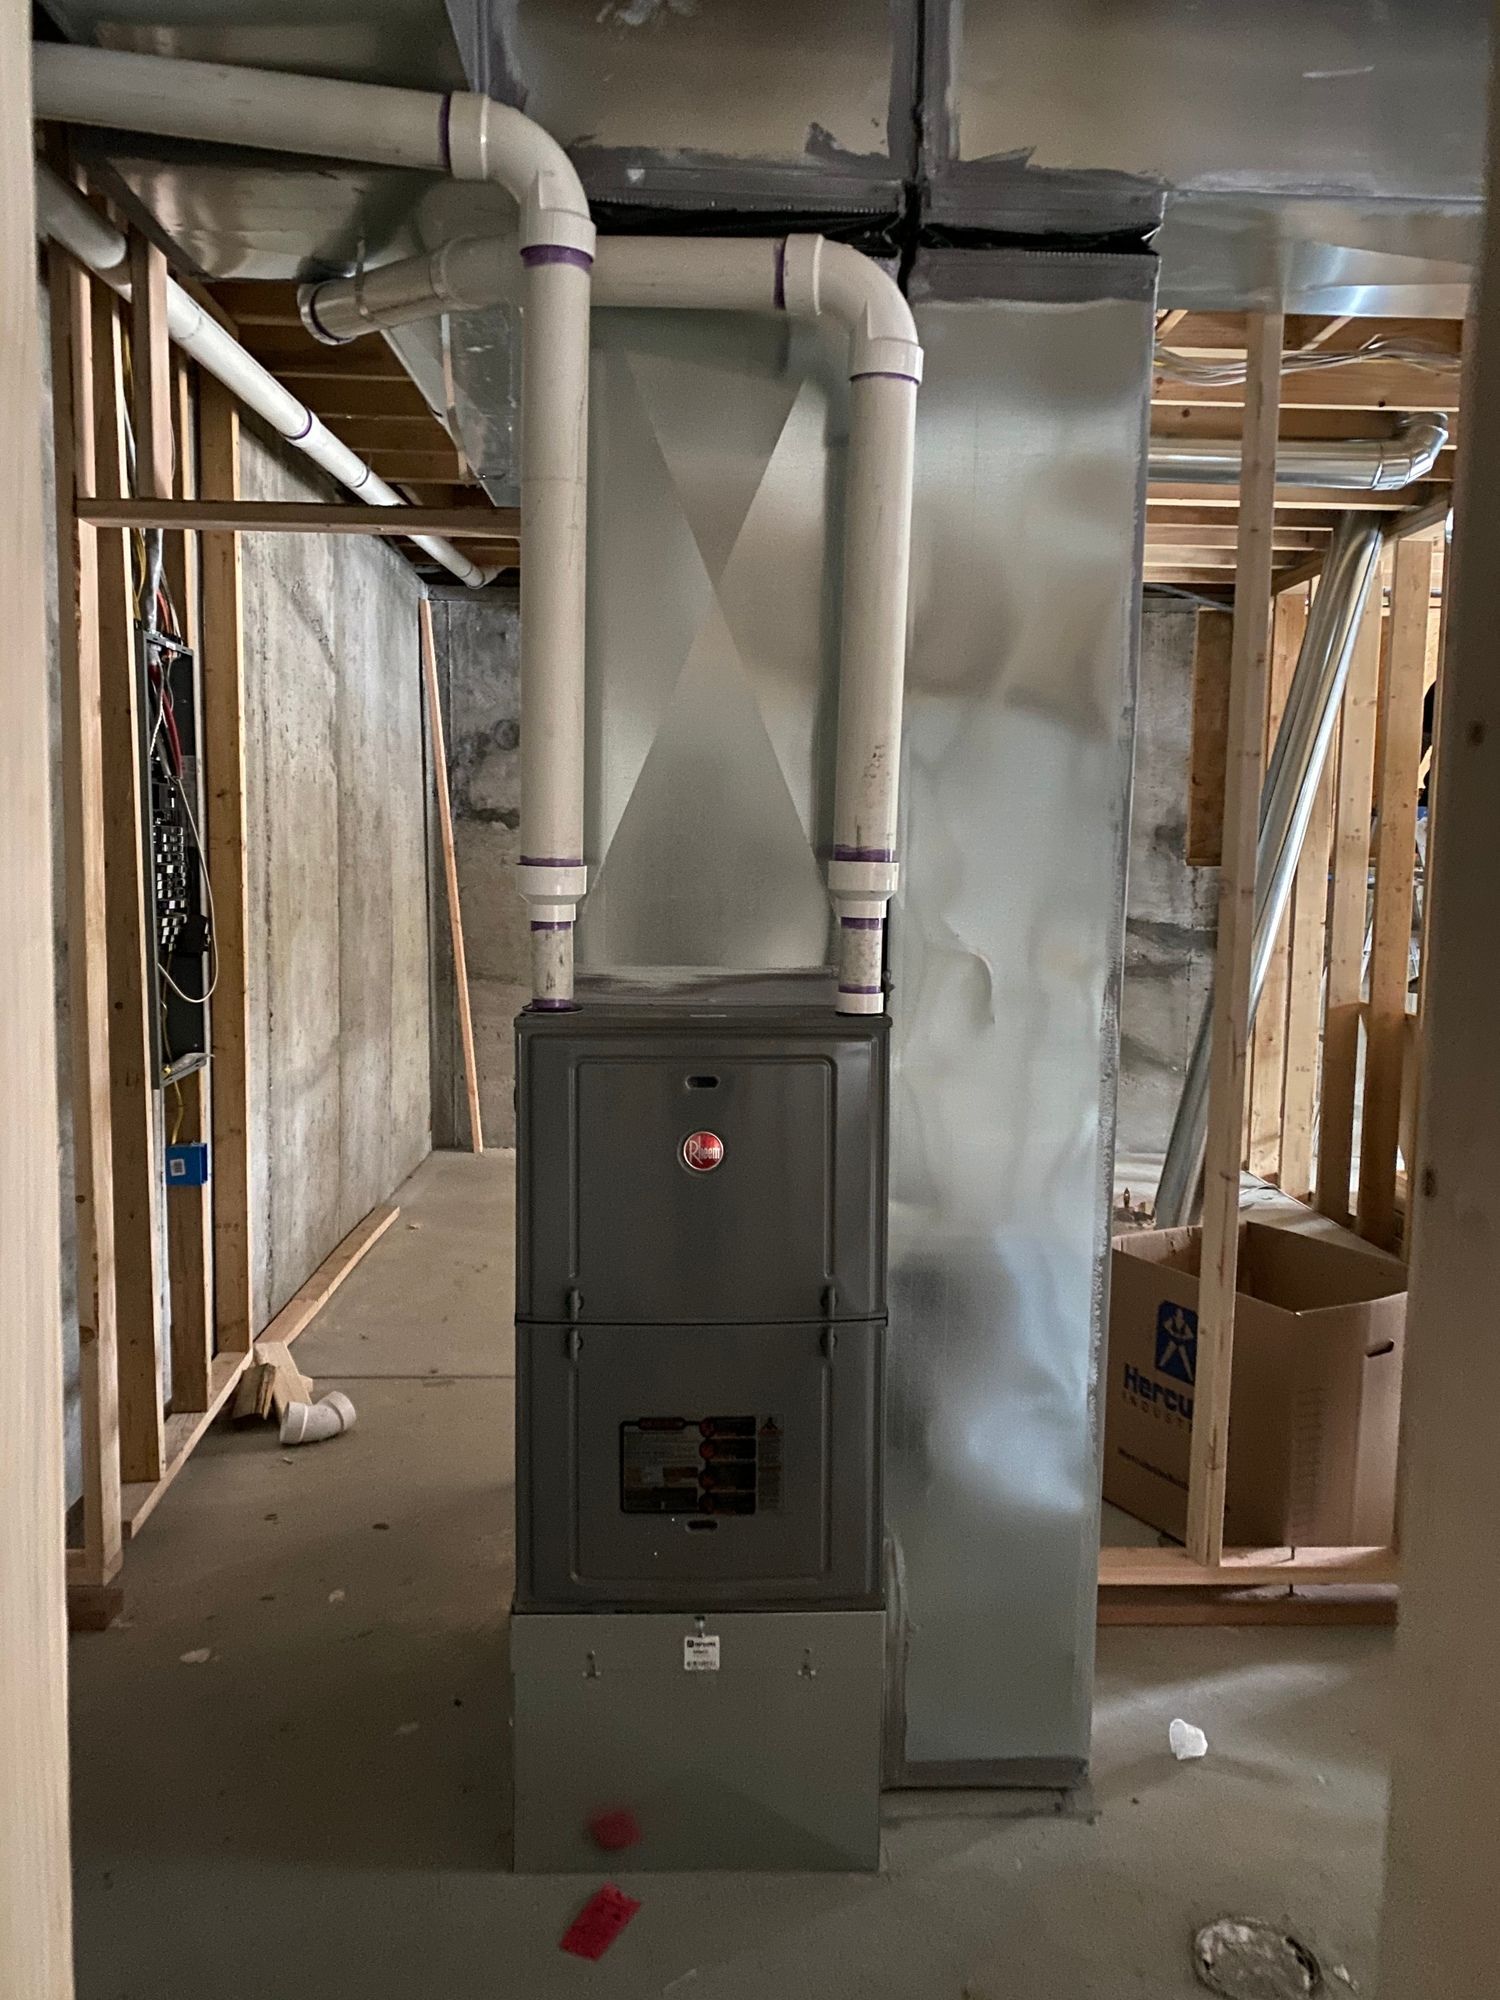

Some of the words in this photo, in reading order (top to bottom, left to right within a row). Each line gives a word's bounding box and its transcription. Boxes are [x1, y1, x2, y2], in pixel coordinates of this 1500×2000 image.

[689, 1136, 720, 1165] Rheem
[1121, 1388, 1192, 1434] INDUST
[1123, 1362, 1193, 1420] Hercu
